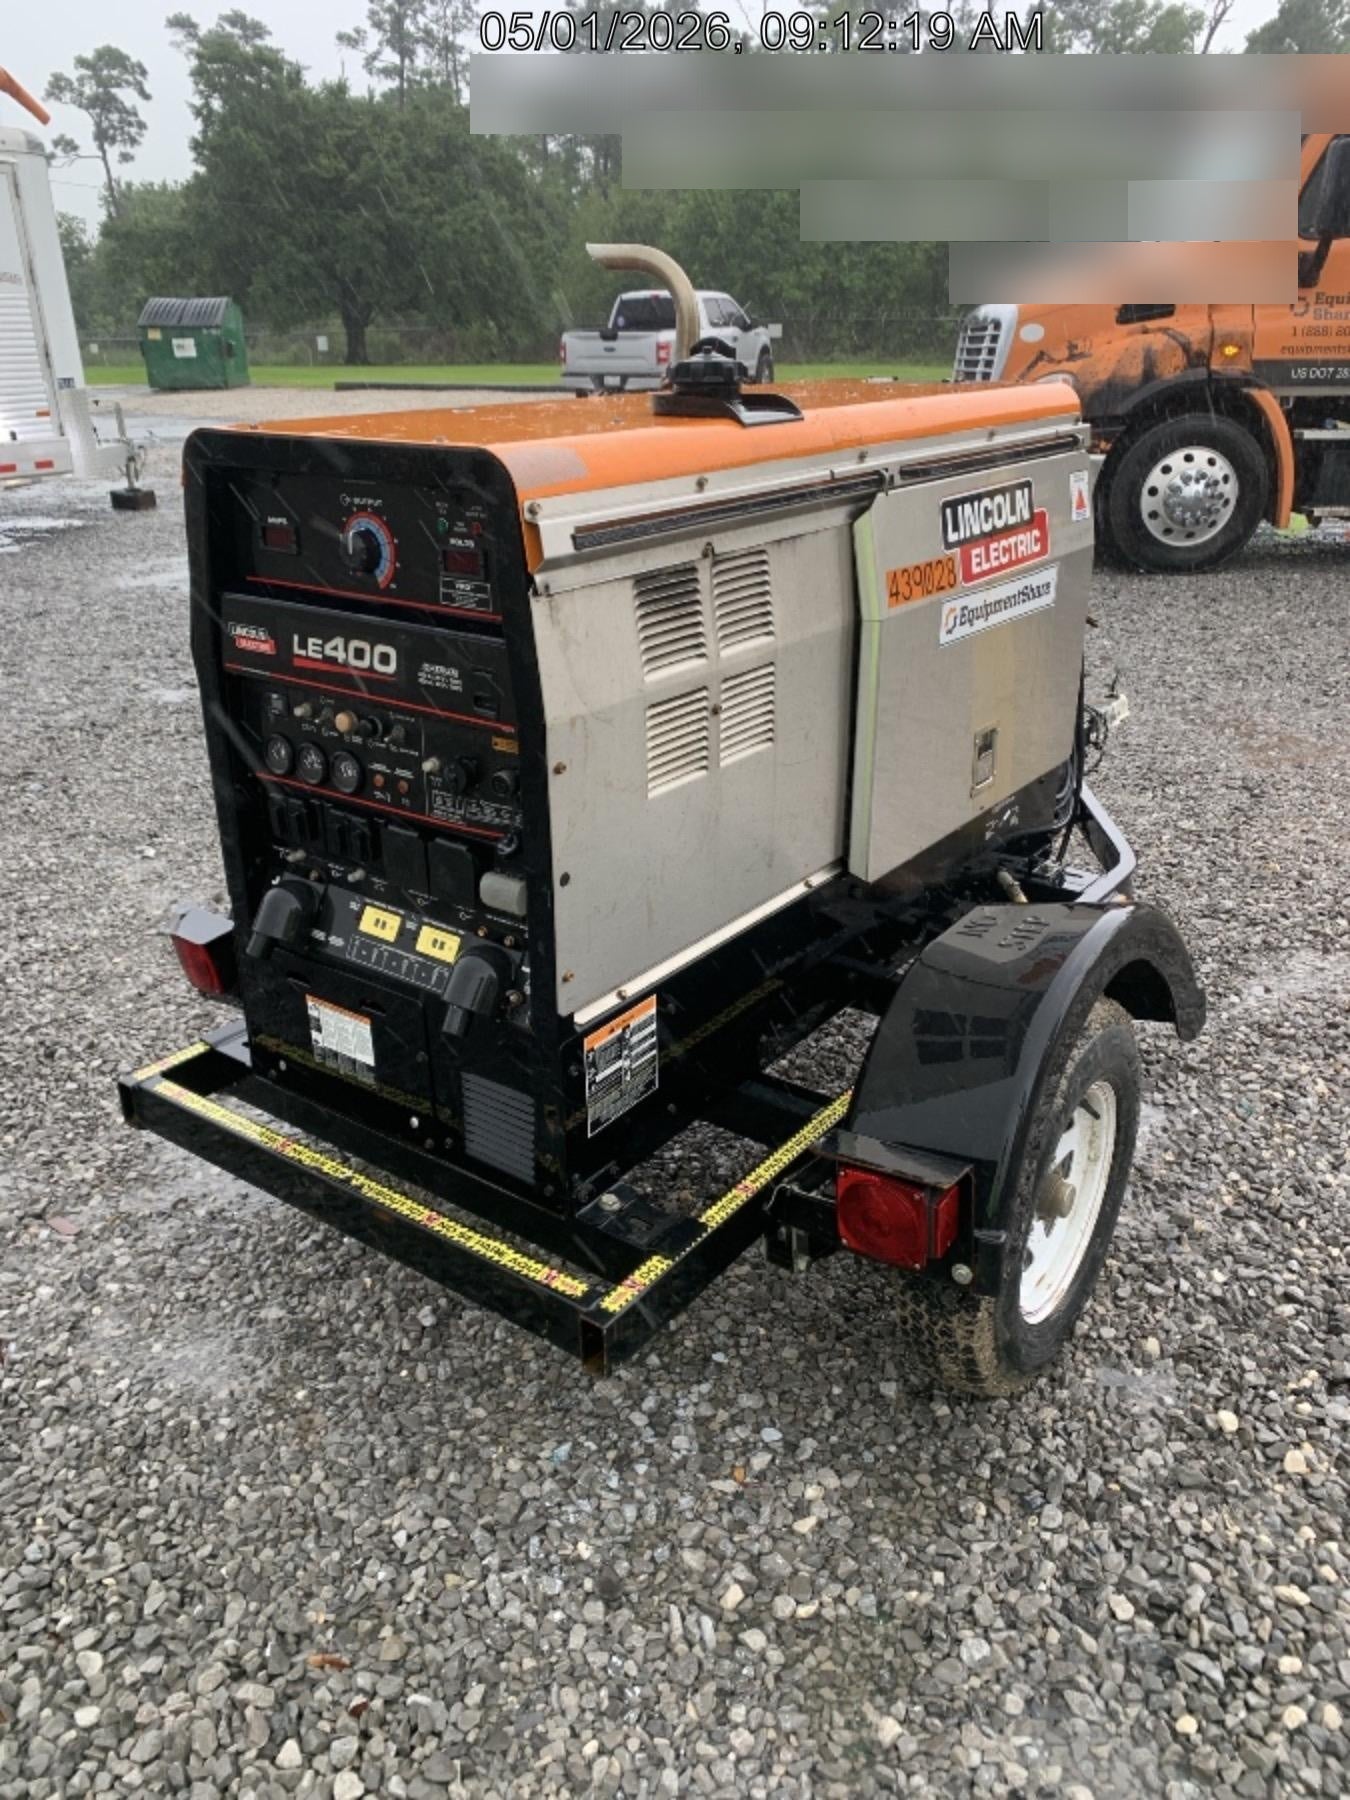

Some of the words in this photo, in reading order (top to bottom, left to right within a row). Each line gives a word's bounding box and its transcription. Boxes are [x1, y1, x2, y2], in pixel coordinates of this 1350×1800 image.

[1291, 367, 1307, 379] US
[1309, 367, 1335, 379] DOT
[945, 487, 1031, 543] LINCOLN
[970, 528, 1041, 575] ELECTRIC
[959, 580, 1052, 627] EquipmentShare
[292, 633, 397, 675] LE400
